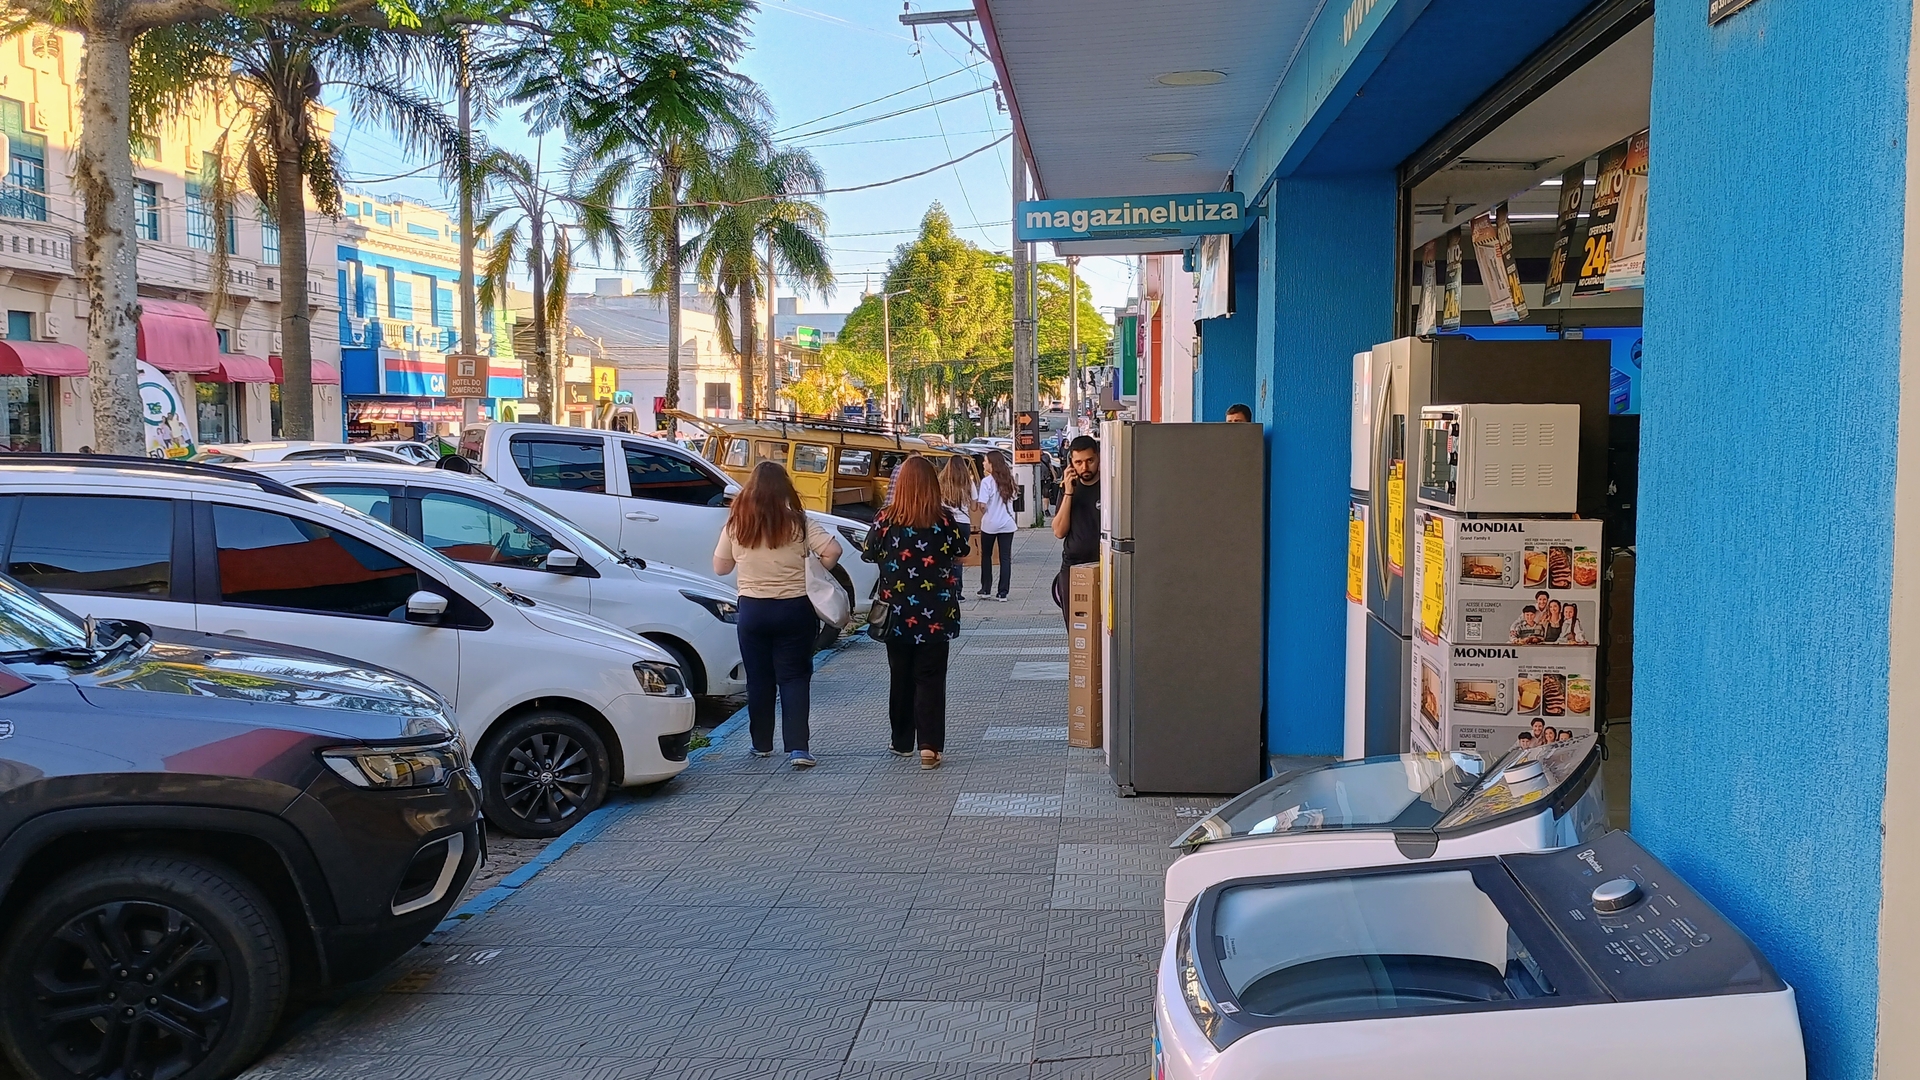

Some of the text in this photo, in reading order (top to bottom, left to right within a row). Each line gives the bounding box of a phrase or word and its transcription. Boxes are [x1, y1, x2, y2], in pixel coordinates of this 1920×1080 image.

[1026, 198, 1238, 232] magazineluiza
[1589, 223, 1607, 236] OFERTAS
[430, 375, 445, 392] CA
[1460, 522, 1525, 533] MONDIAL
[1076, 639, 1085, 647] 65
[1454, 648, 1519, 659] MONDIAL
[1586, 855, 1604, 874] Electrolux
